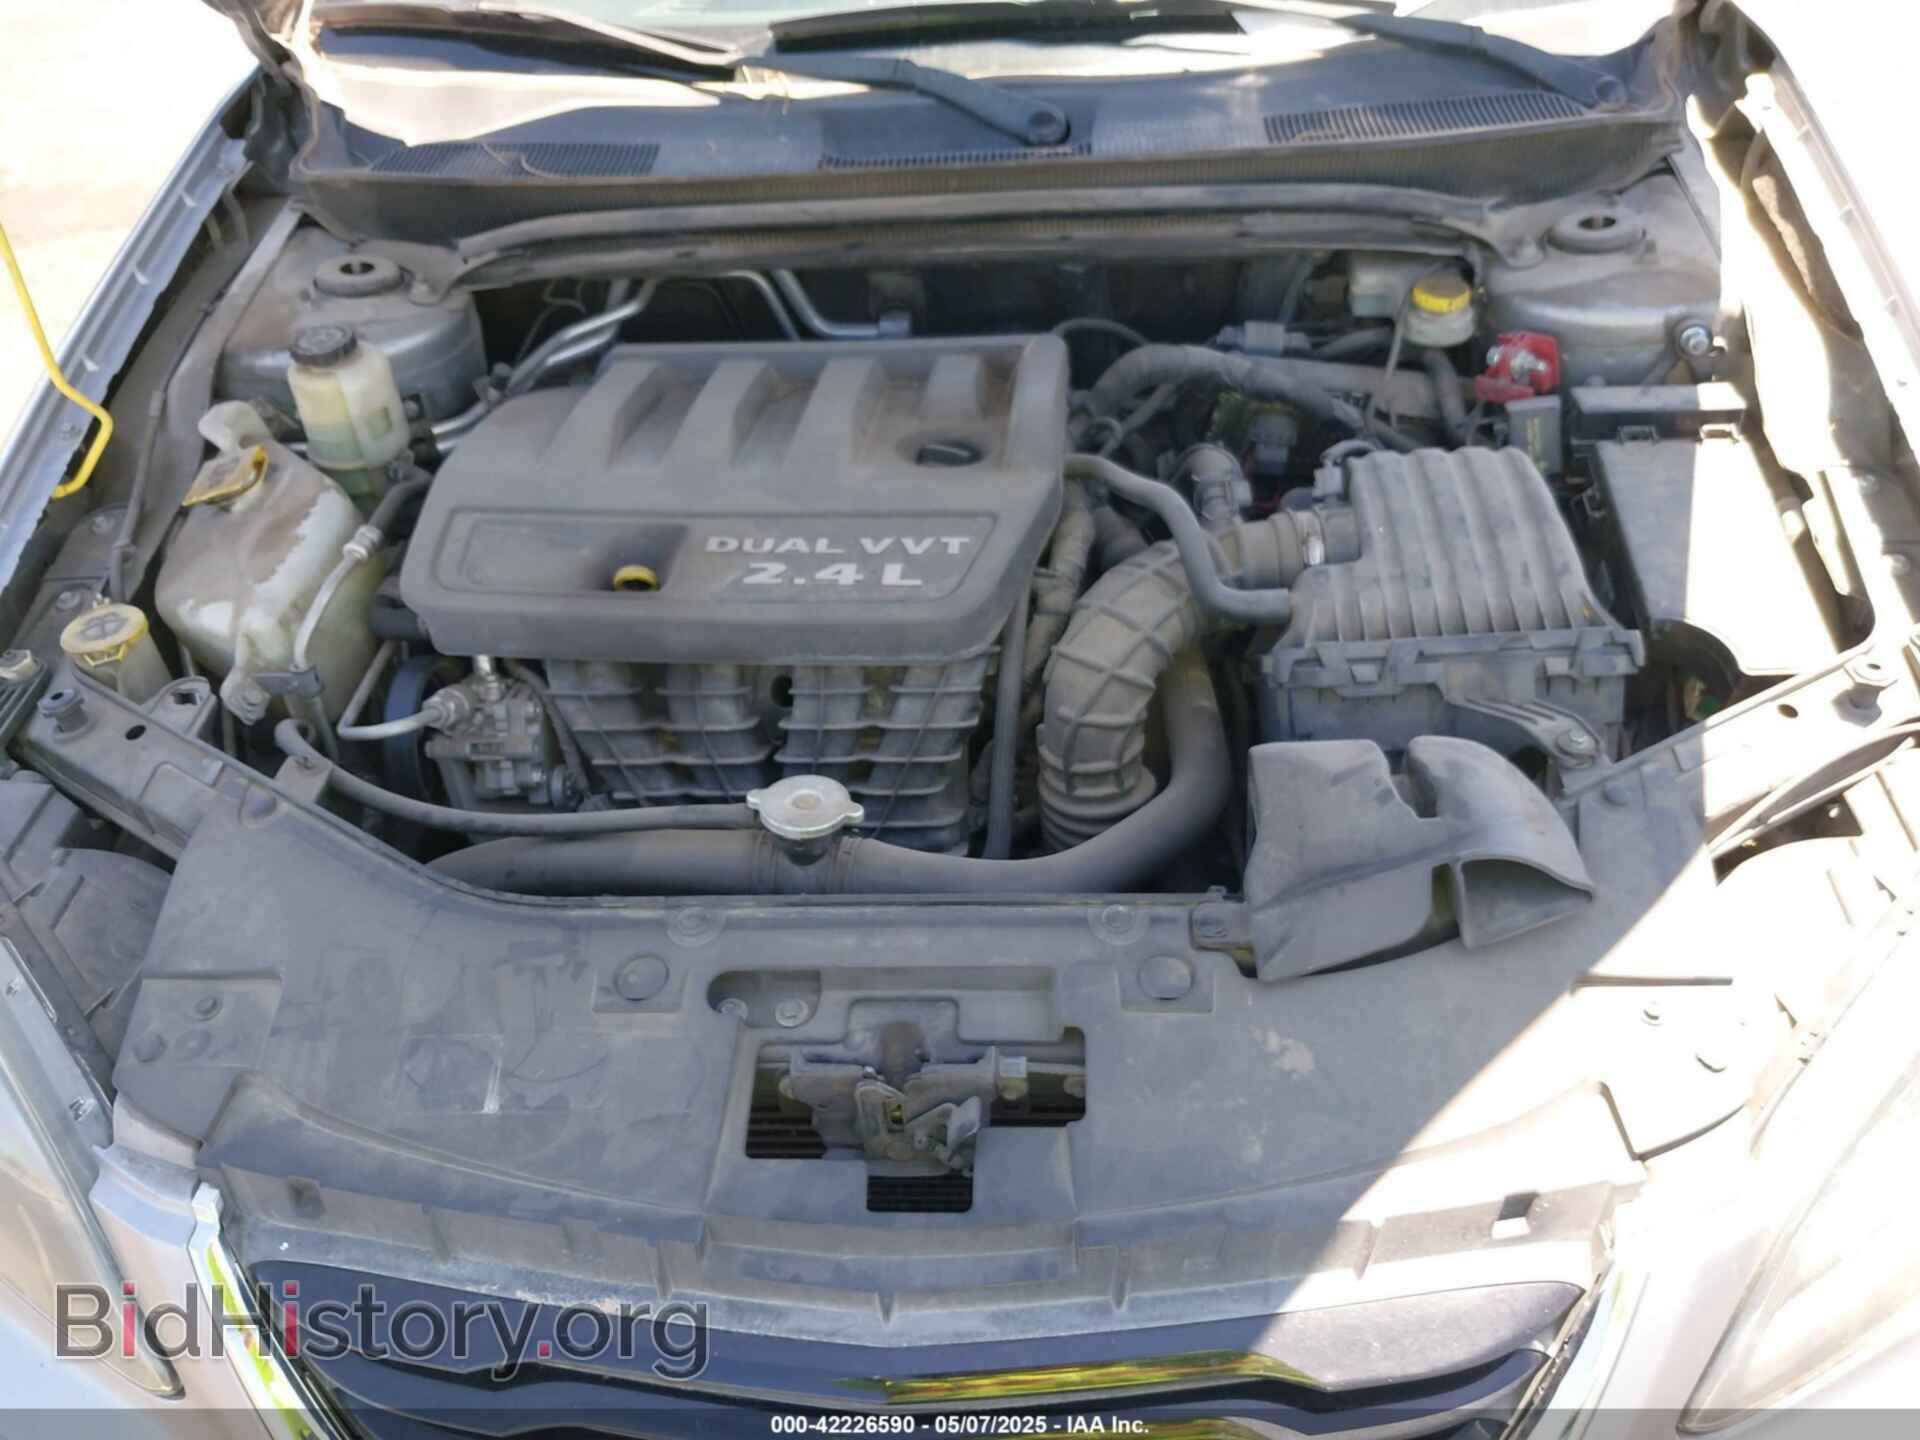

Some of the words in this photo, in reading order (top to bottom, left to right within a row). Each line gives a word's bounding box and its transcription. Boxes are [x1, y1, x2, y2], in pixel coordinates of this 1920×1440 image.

[704, 537, 845, 553] DUAL
[859, 537, 970, 554] VVT
[743, 562, 864, 585] 2.4
[881, 563, 923, 586] L
